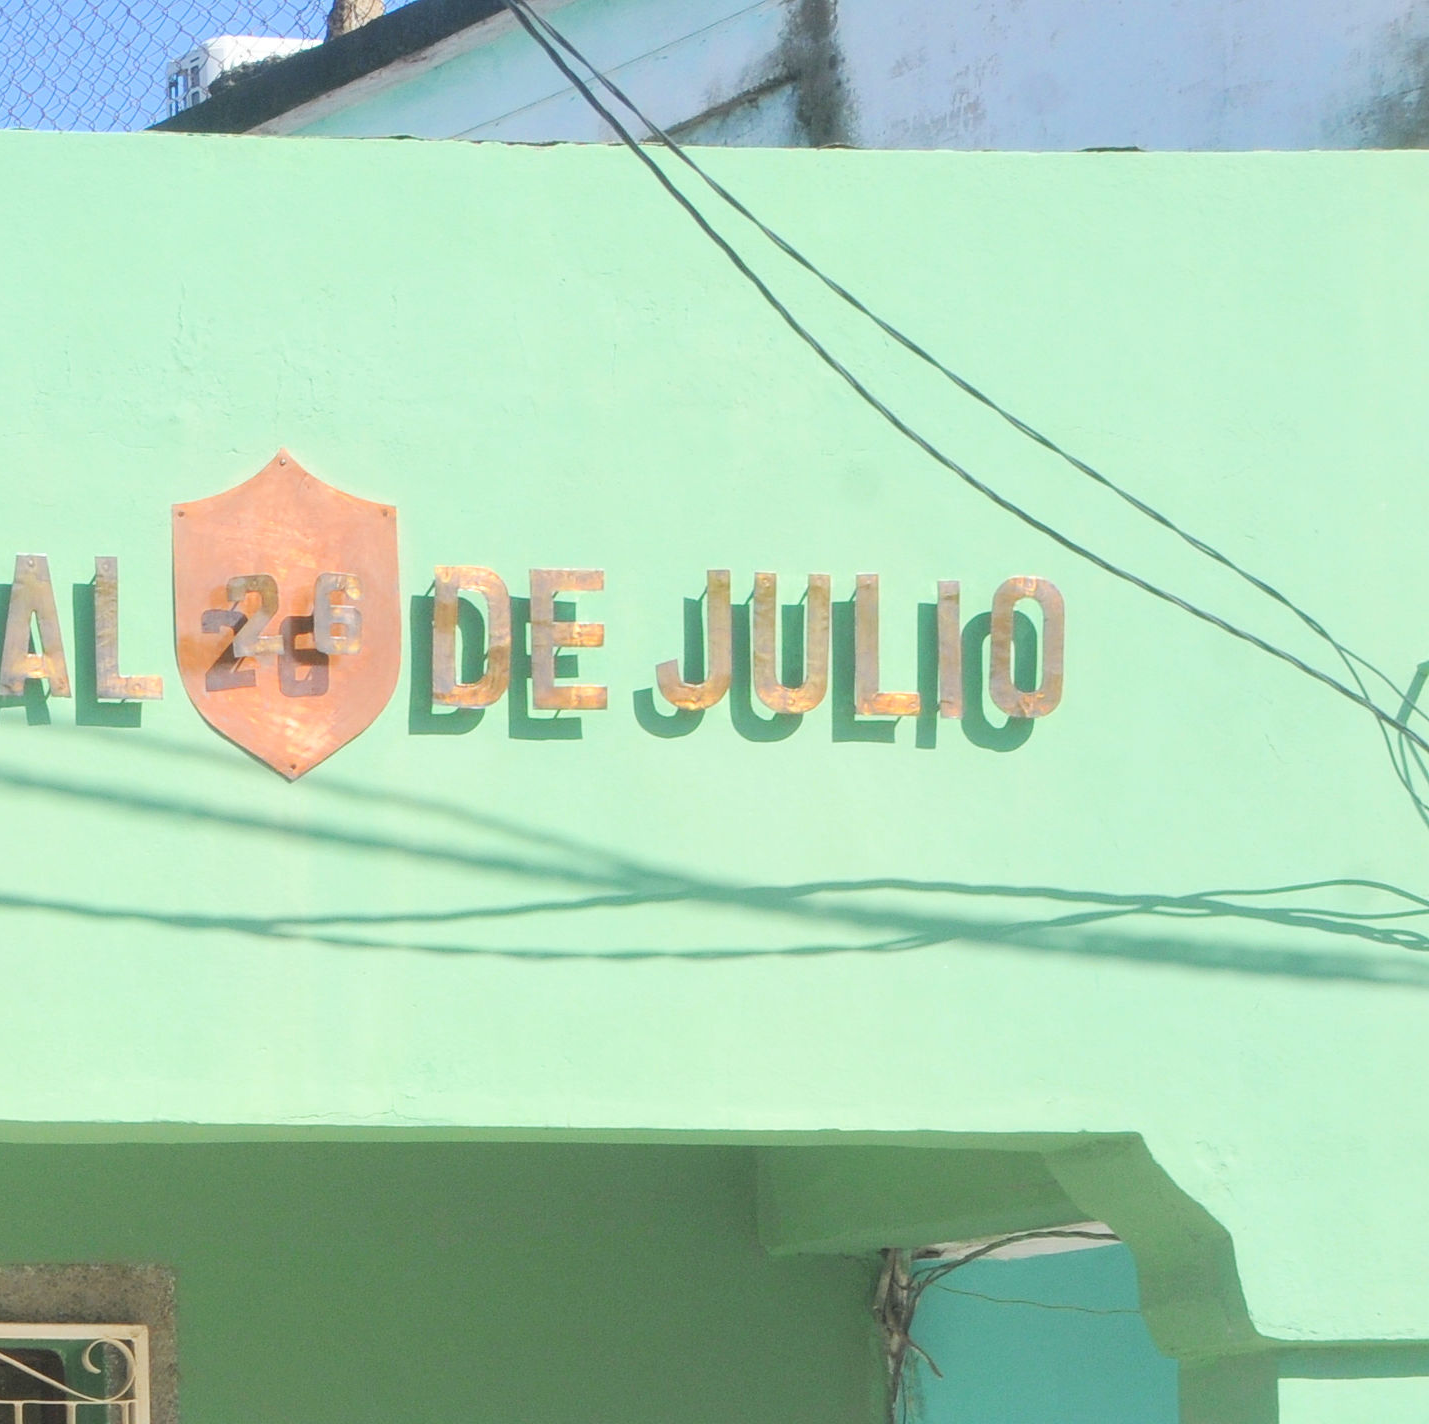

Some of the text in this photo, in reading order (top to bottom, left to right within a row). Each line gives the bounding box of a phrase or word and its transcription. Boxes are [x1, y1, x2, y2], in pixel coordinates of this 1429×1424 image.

[226, 571, 362, 659] 26
[431, 564, 608, 711] DE
[655, 568, 1065, 720] JULIO
